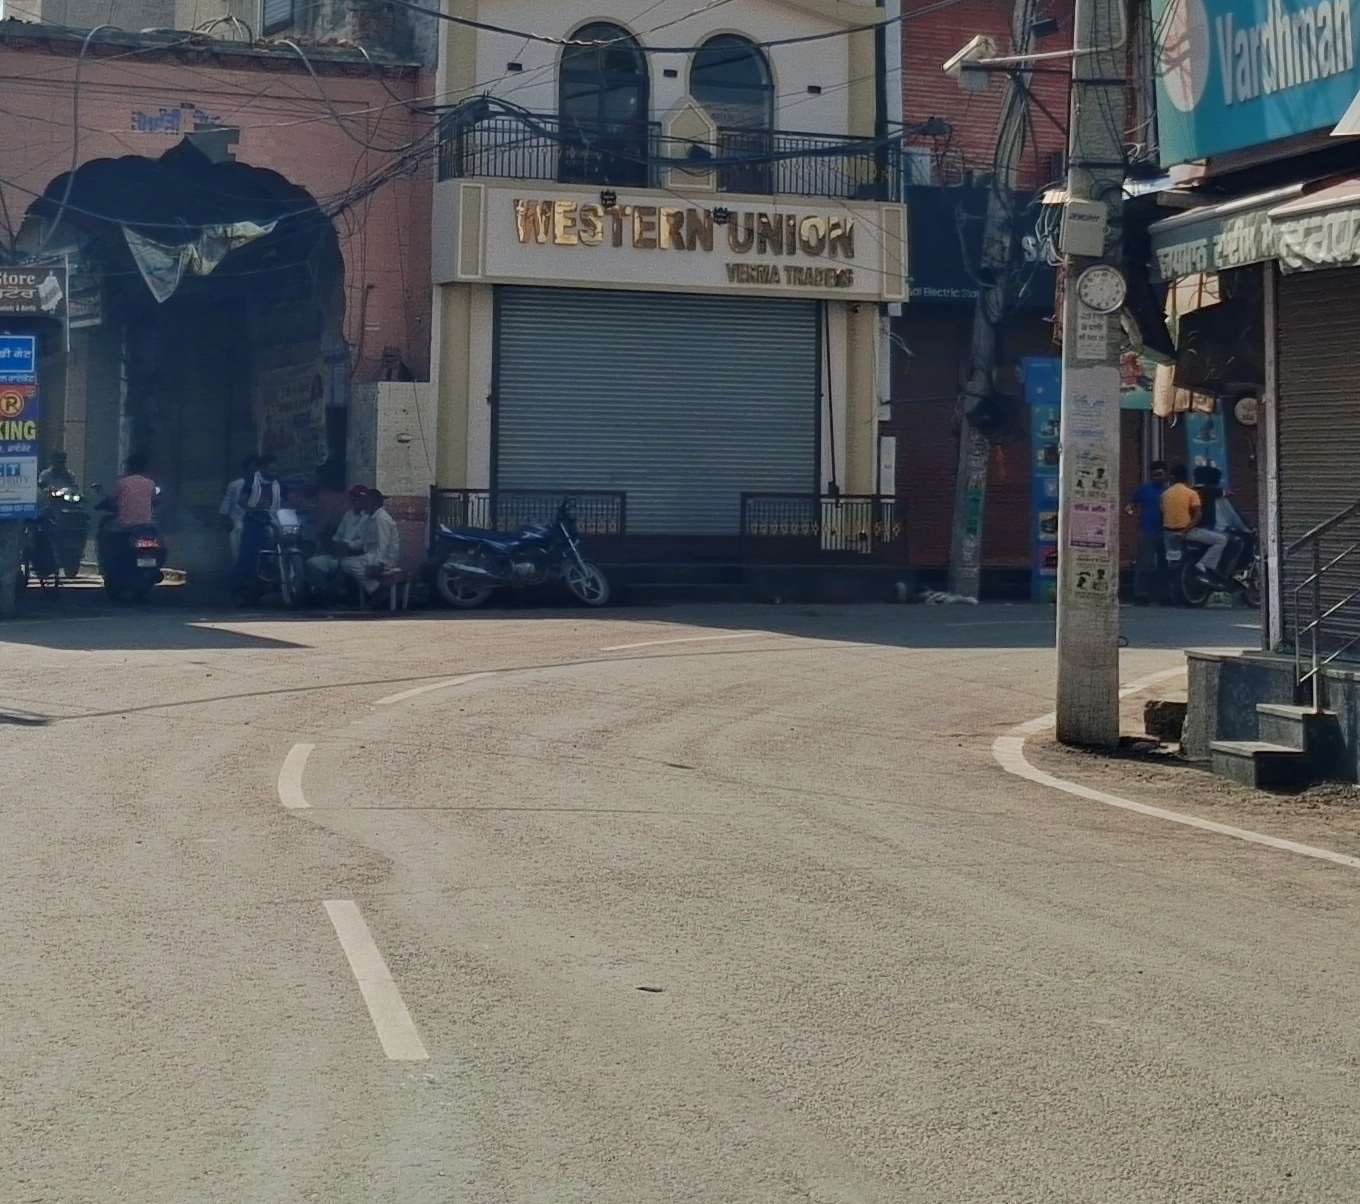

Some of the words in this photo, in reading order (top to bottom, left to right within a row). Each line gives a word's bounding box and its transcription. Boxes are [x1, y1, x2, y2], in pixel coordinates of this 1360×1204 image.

[512, 198, 715, 252] WESTERN
[726, 210, 856, 259] UNION
[724, 262, 781, 286] VERMA
[783, 263, 855, 288] TRADERS
